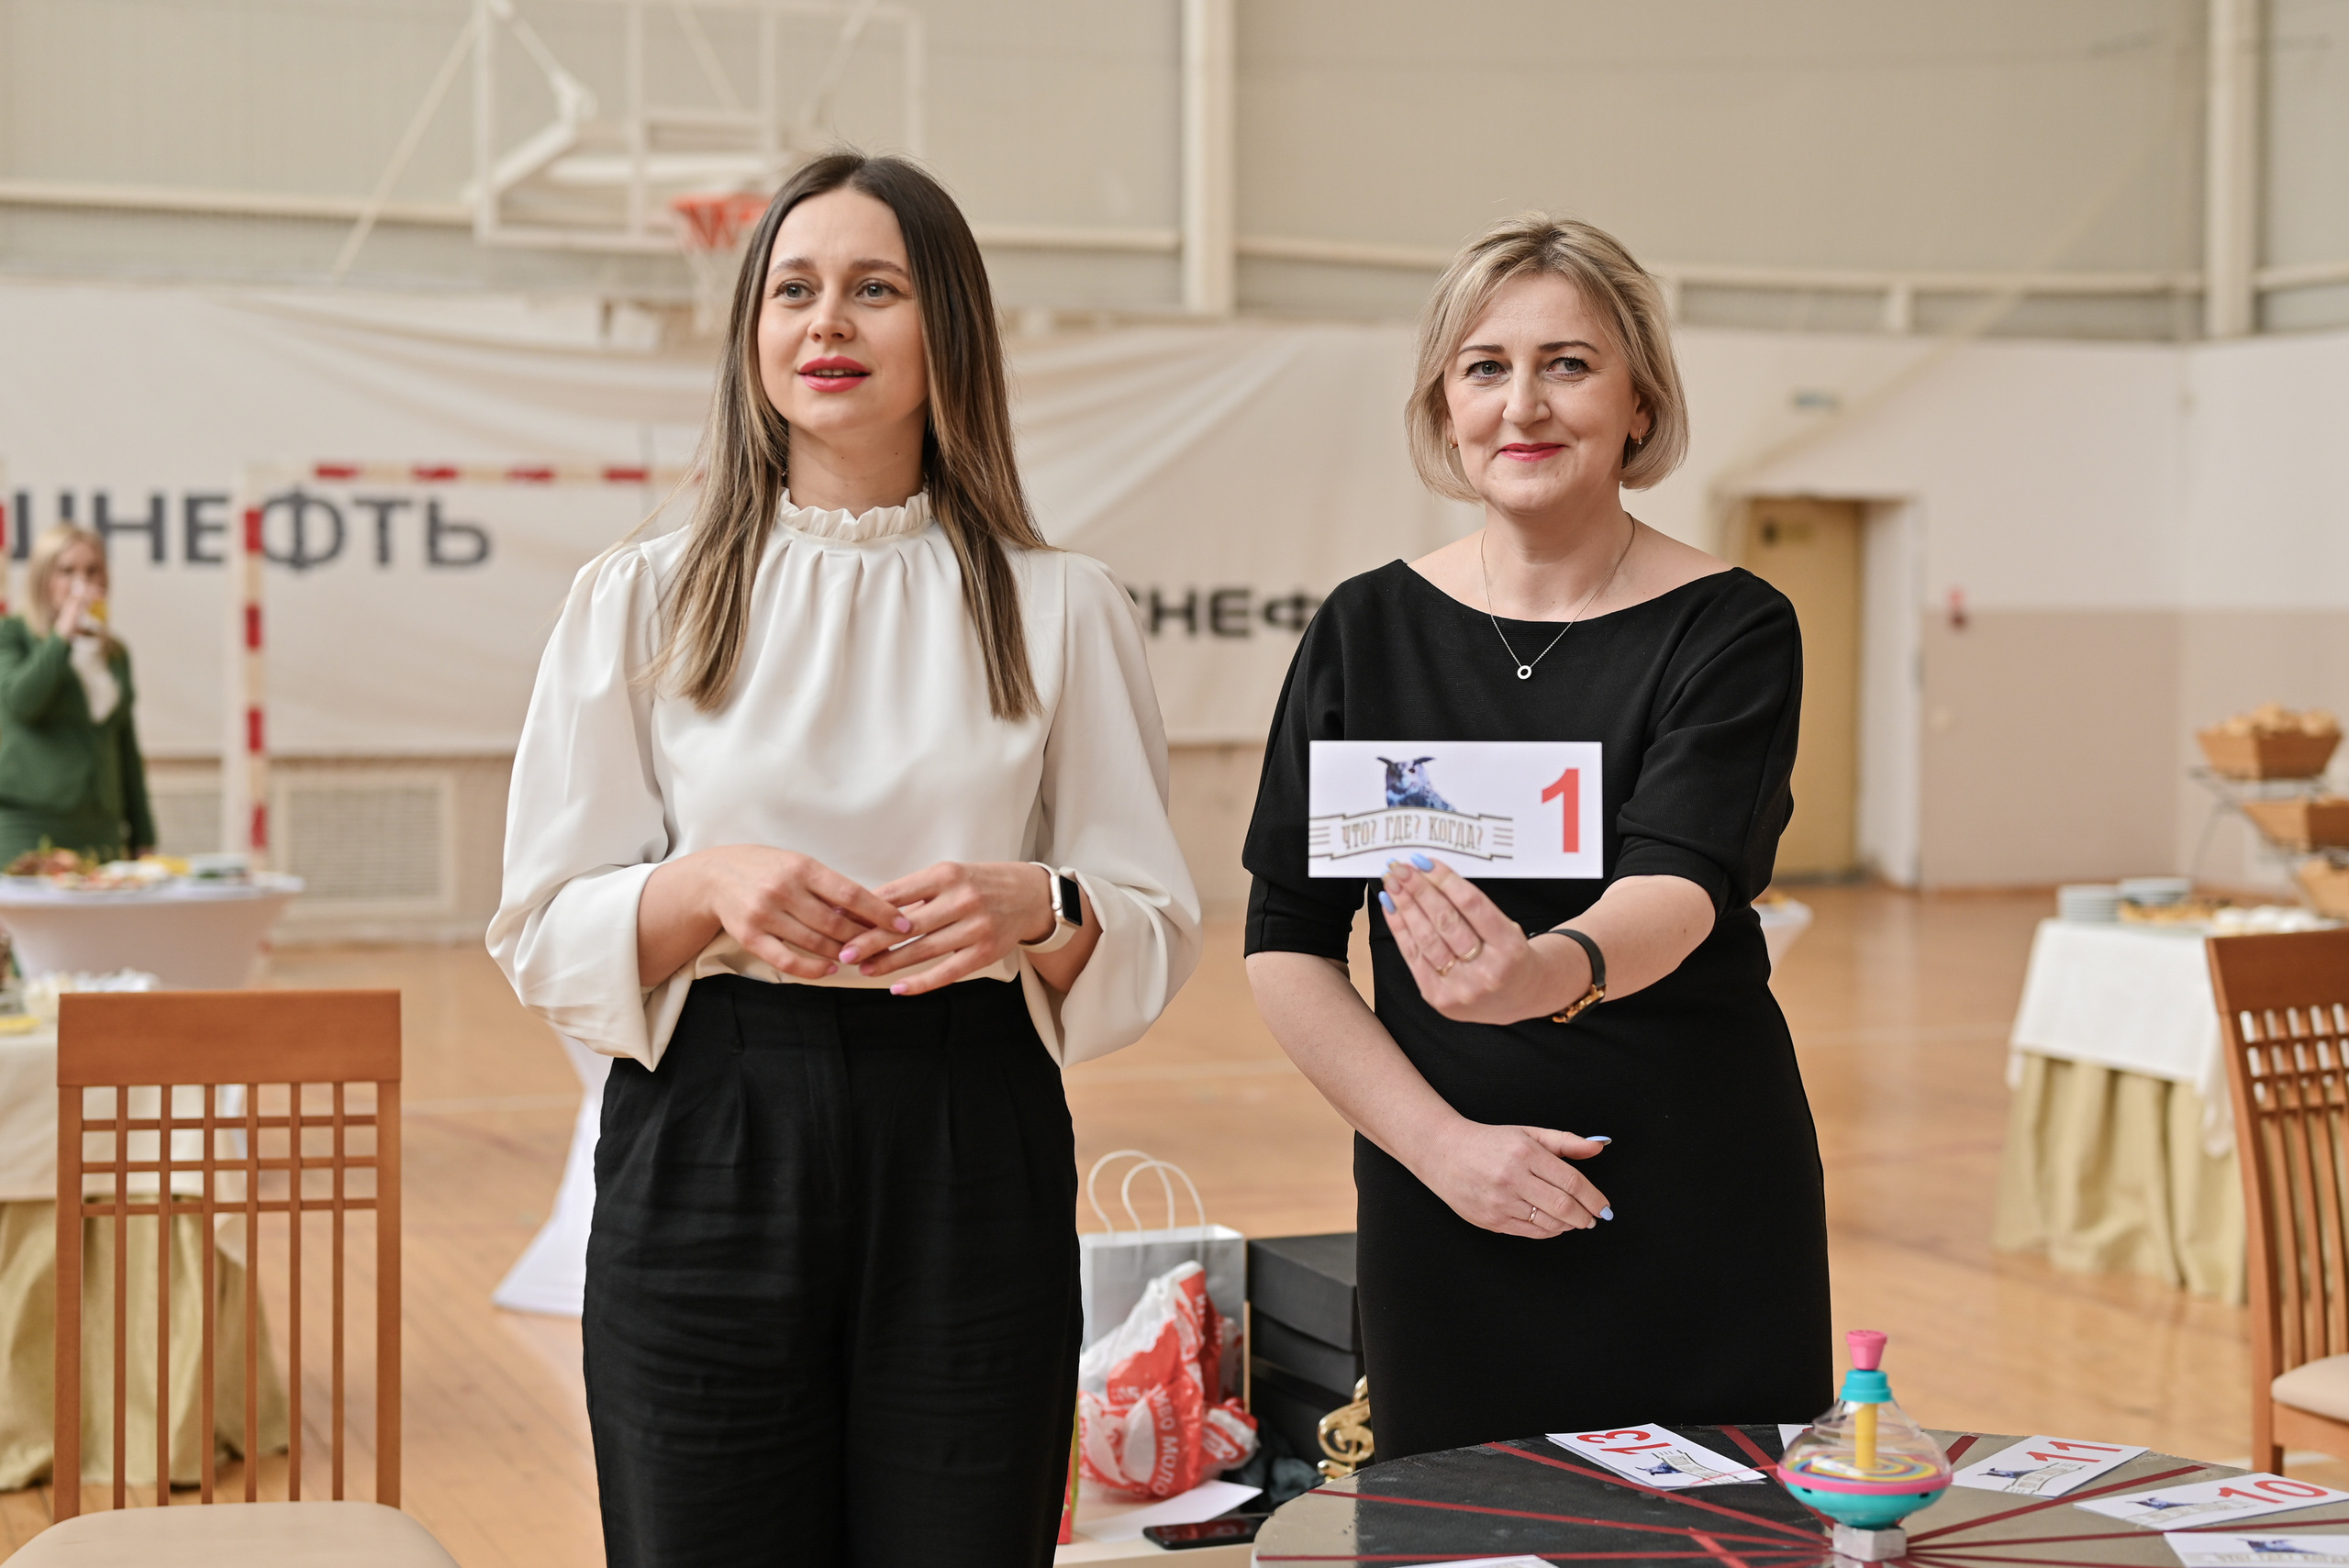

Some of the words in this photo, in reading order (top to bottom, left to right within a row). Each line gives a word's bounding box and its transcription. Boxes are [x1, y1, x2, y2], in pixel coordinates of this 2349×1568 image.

[1127, 585, 1328, 638] НЕФ
[1541, 767, 1580, 853] 1
[1341, 818, 1376, 850] ЧТО?
[1385, 815, 1420, 842] ГДЕ?
[1429, 816, 1483, 851] КОГДА?
[1575, 1429, 1673, 1455] 13
[2025, 1440, 2123, 1463] 11
[2218, 1479, 2329, 1505] 10
